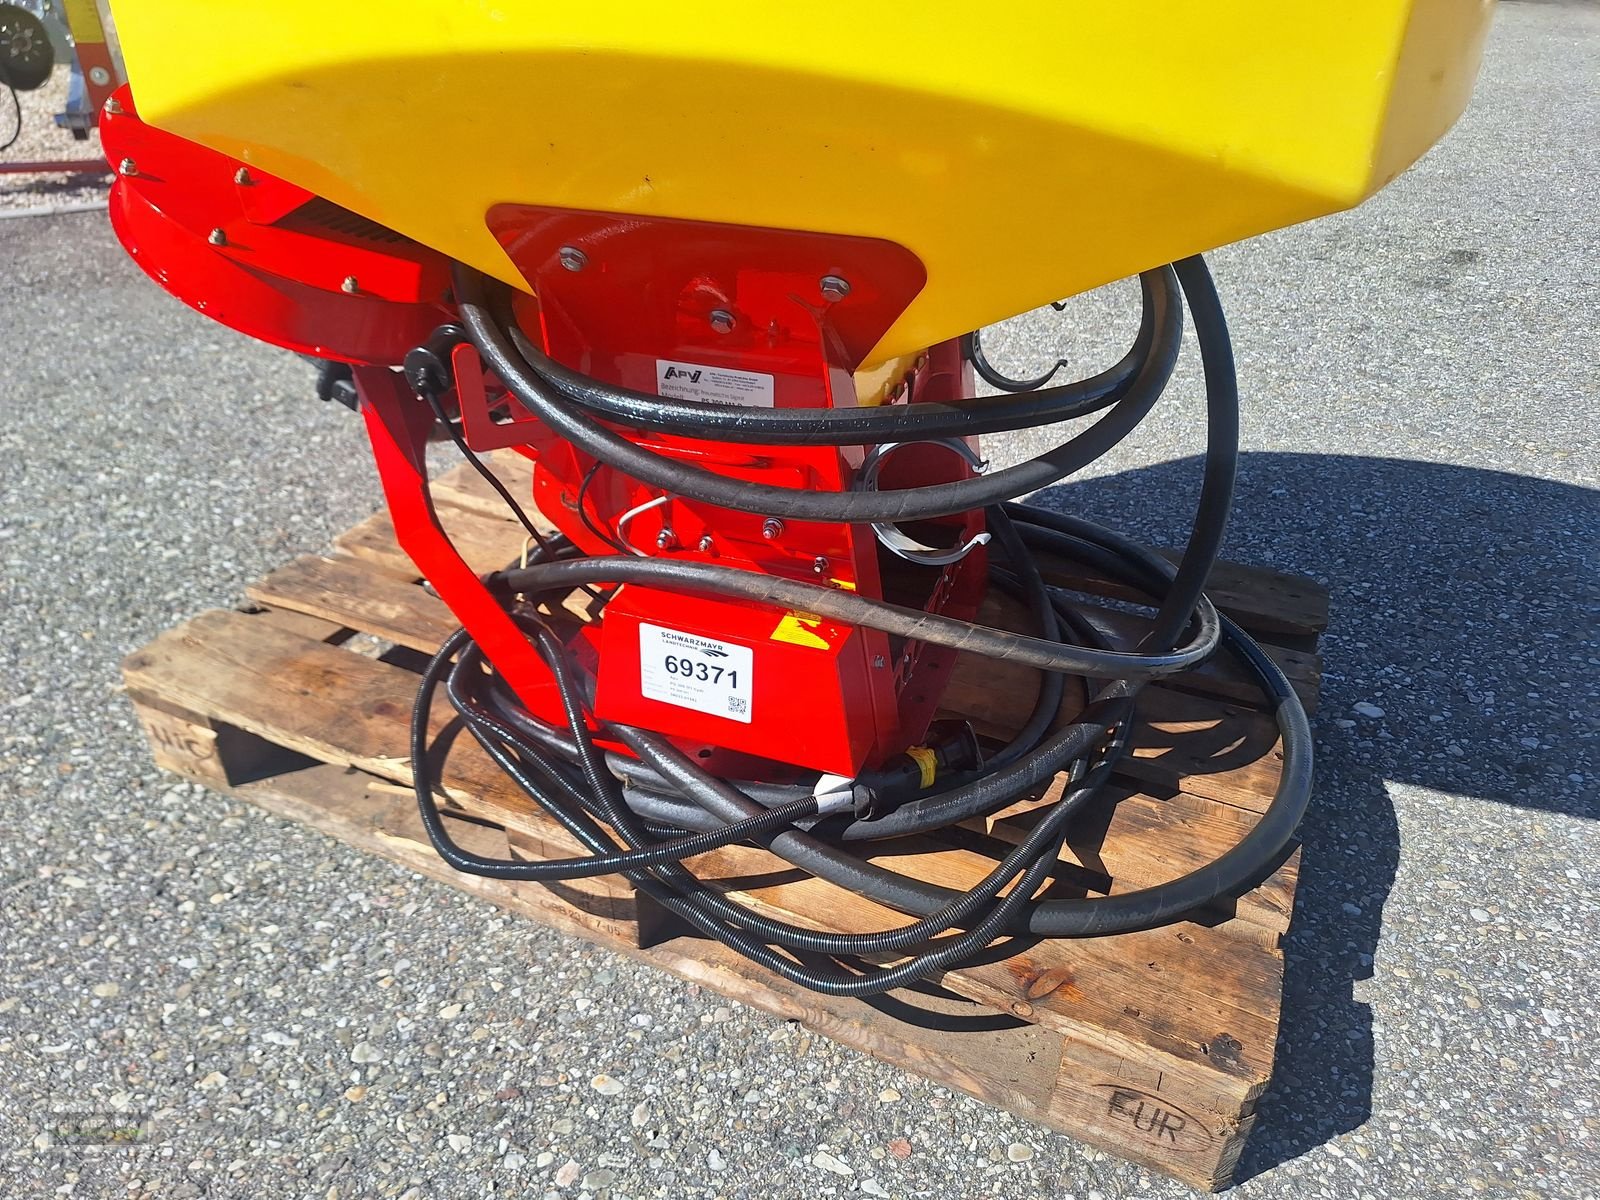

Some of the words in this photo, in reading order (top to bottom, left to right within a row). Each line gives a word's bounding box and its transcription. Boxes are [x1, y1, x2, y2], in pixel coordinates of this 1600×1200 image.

[661, 632, 724, 651] SCHWARZMAYR
[662, 639, 698, 651] LANDTECHNIK
[665, 655, 737, 689] 69371
[1108, 1091, 1186, 1142] EUR
